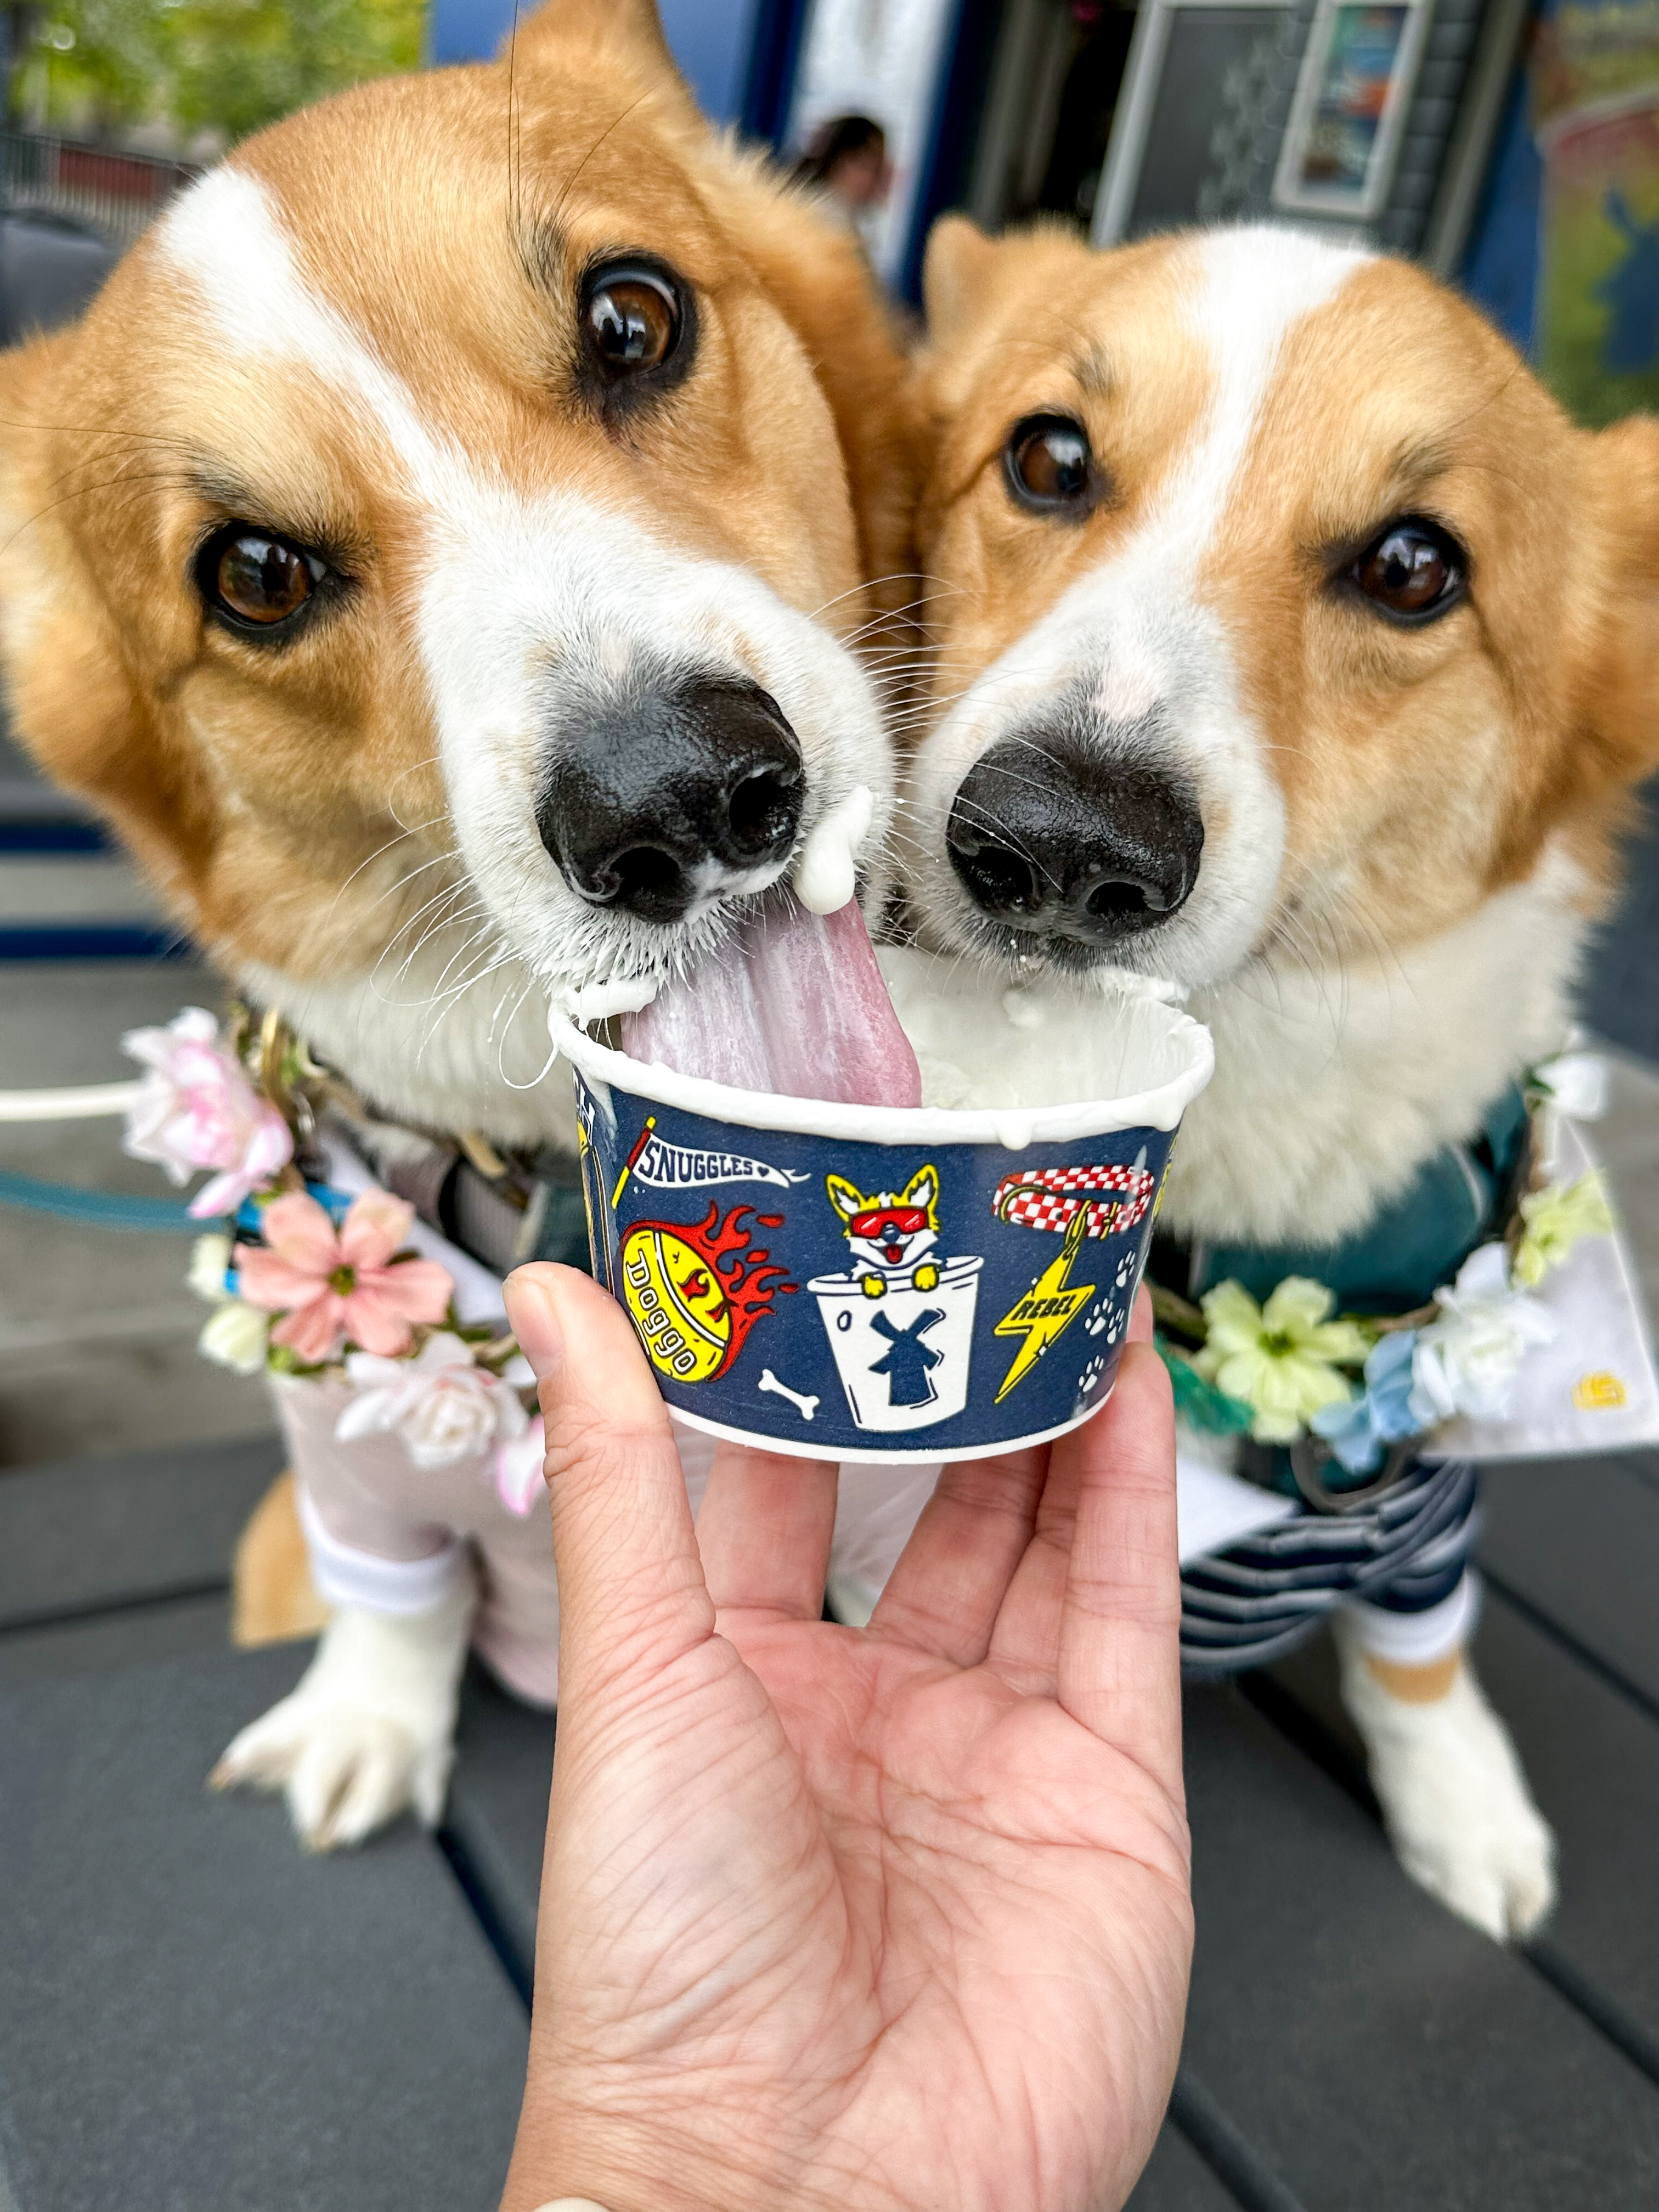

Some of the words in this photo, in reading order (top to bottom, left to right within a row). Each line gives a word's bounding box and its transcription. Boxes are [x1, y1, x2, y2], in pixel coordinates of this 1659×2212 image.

[638, 1140, 753, 1183] SNUGGLES
[626, 1248, 697, 1375] Doggo
[1010, 1294, 1077, 1321] REBEL
